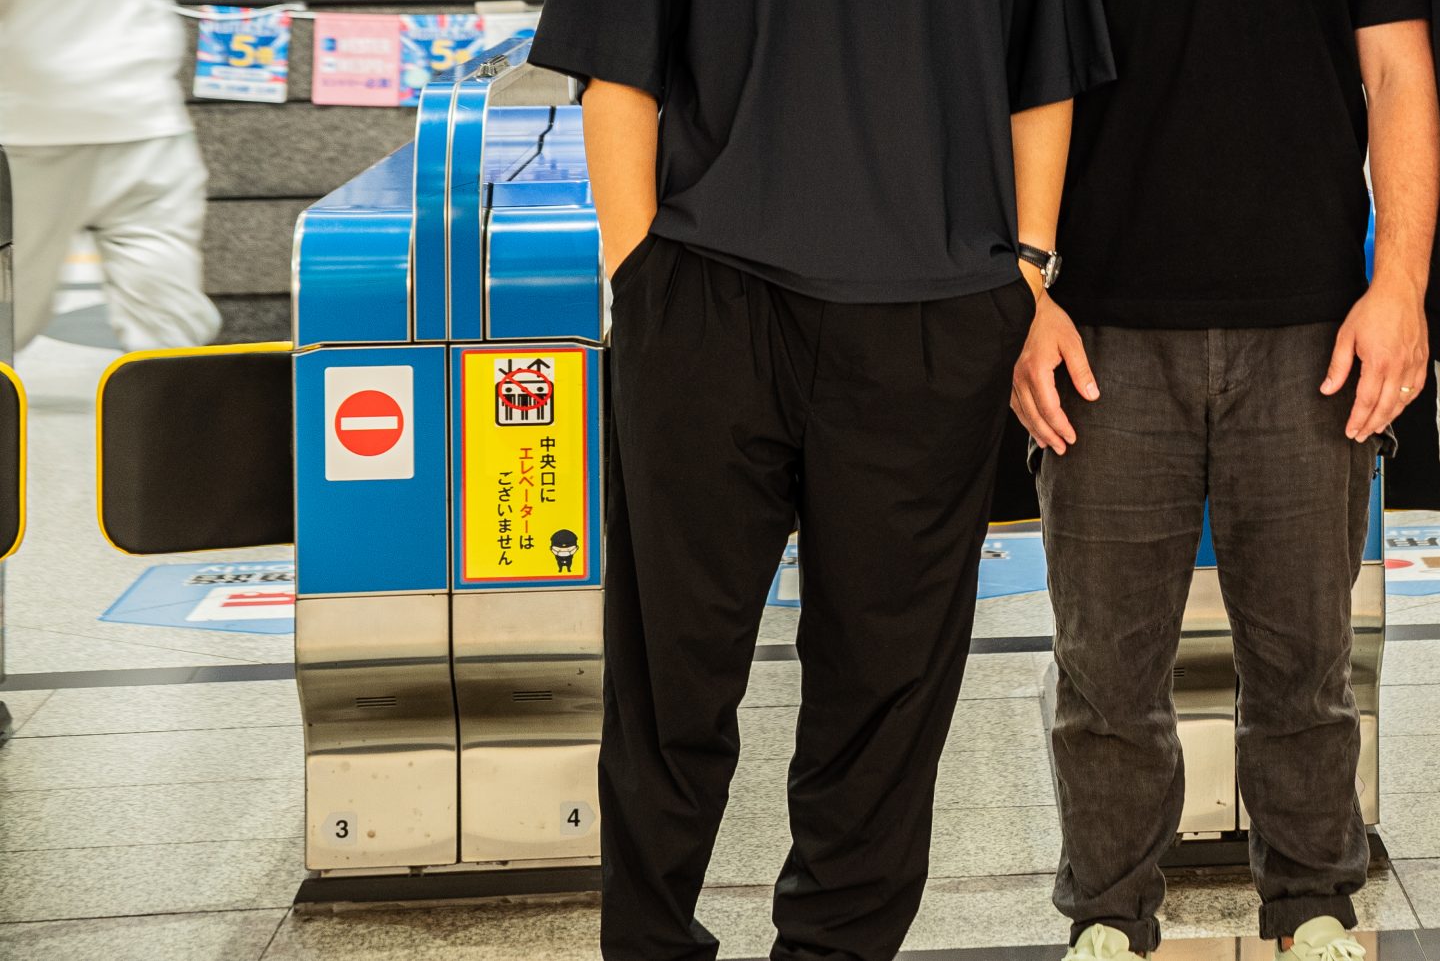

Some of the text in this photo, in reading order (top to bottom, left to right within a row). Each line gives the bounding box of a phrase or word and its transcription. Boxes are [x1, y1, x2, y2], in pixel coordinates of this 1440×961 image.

[519, 447, 534, 550] エレベーターは
[540, 436, 556, 503] 中央口に
[497, 471, 513, 566] ございません
[335, 819, 349, 839] 3
[567, 808, 581, 827] 4
